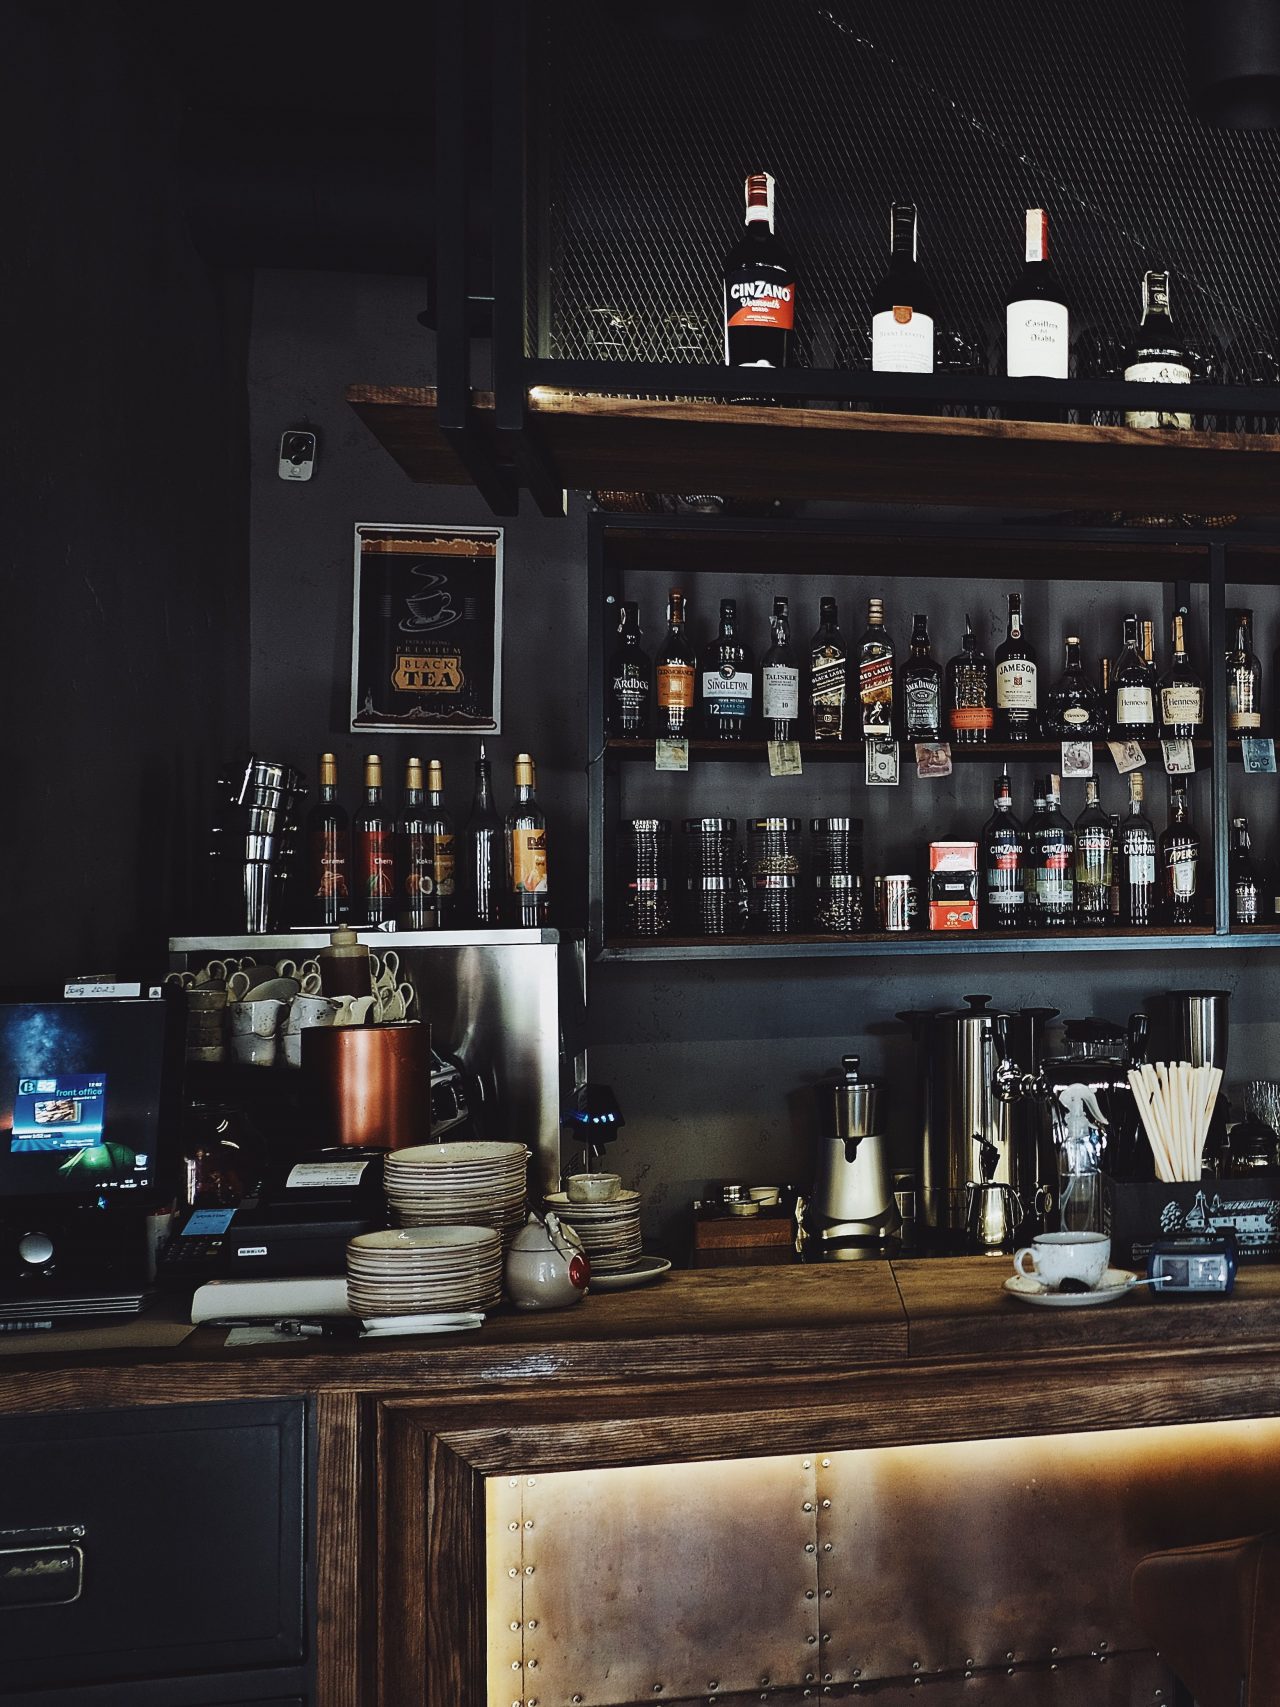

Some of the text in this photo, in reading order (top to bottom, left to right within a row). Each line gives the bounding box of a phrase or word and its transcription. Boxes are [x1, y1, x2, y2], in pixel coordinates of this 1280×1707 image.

[730, 280, 791, 302] CINZANO
[740, 297, 780, 309] Vermouth
[396, 646, 461, 655] PREMIUM
[405, 660, 451, 669] BLACK
[999, 663, 1035, 675] JAMESON
[812, 674, 829, 684] BLACK
[829, 668, 846, 678] LABEL
[859, 672, 872, 680] RED
[873, 665, 893, 676] LABEL
[403, 671, 454, 687] TEA
[707, 679, 749, 691] SINGLETON
[1169, 698, 1199, 707] Hennessy
[709, 704, 720, 715] 12
[1168, 763, 1179, 772] 5
[1041, 843, 1073, 854] CINZANO
[1079, 838, 1110, 848] CINZANO
[990, 844, 1023, 855] CINZANO
[373, 857, 393, 866] Cherry
[56, 1088, 103, 1097] front office
